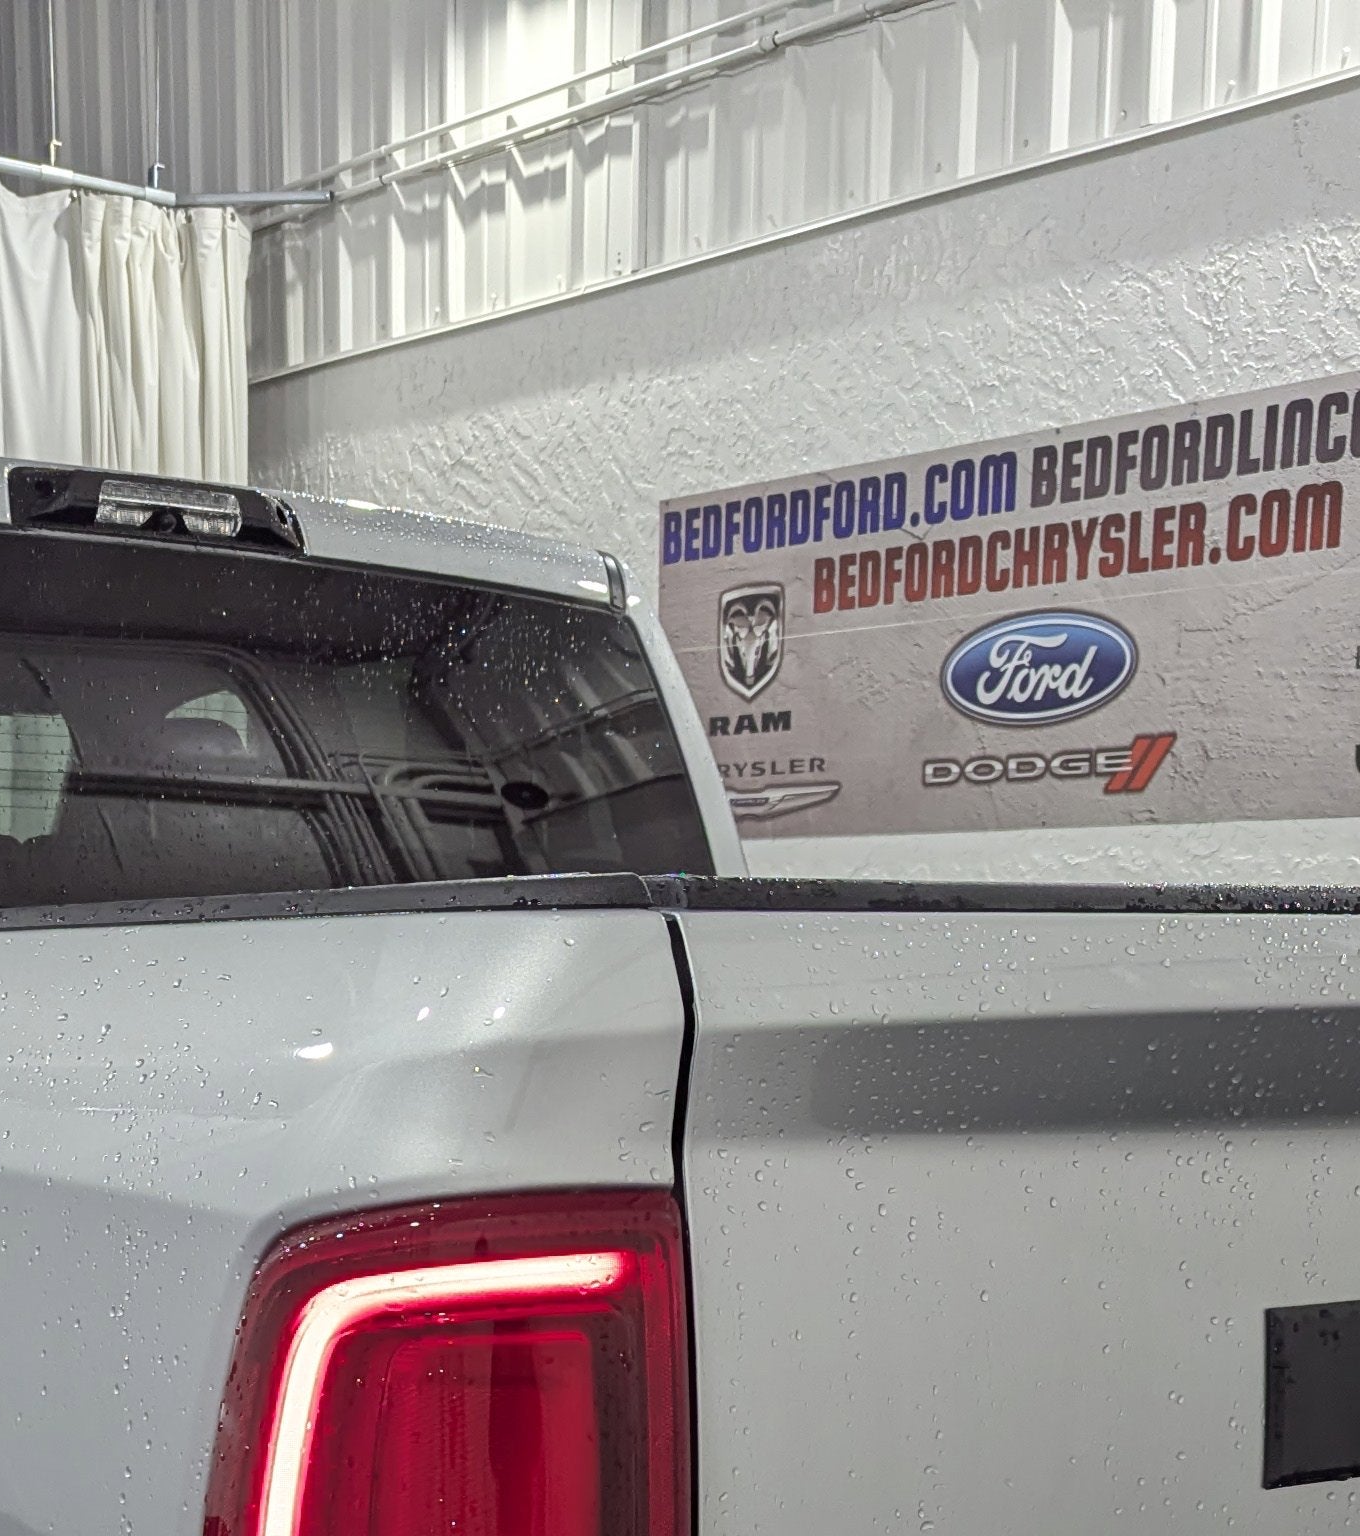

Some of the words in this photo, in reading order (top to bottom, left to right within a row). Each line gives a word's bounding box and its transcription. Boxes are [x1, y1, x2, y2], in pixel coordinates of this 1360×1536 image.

[662, 450, 1018, 566] BEDFORDFORD.COM
[812, 479, 1344, 614] BEDFORDCHRYSLER.COM
[975, 632, 1099, 705] Ford
[708, 710, 793, 737] RAM
[718, 756, 827, 778] RYSLER
[921, 747, 1134, 788] DODGE
